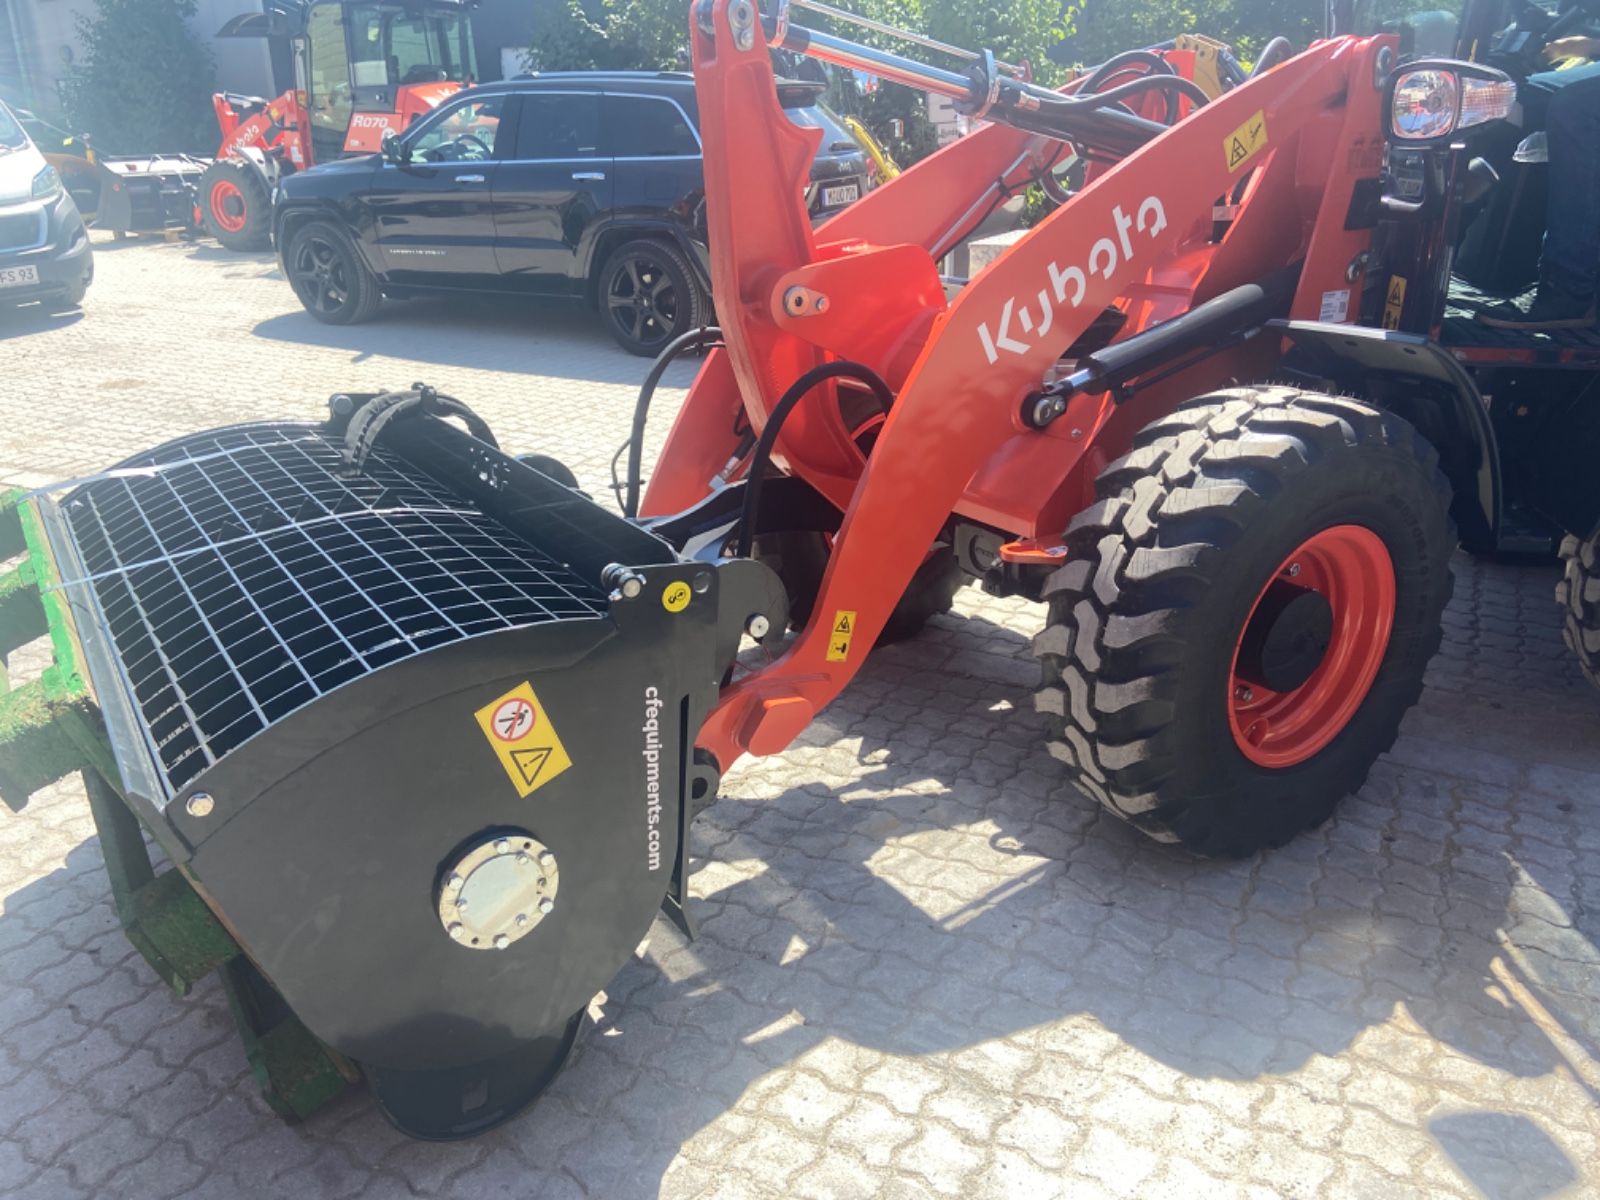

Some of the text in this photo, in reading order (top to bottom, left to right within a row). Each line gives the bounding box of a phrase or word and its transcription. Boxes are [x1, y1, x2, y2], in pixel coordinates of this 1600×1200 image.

[19, 268, 33, 281] 93
[977, 196, 1167, 365] Kubota
[642, 686, 663, 871] cfequipments.com
